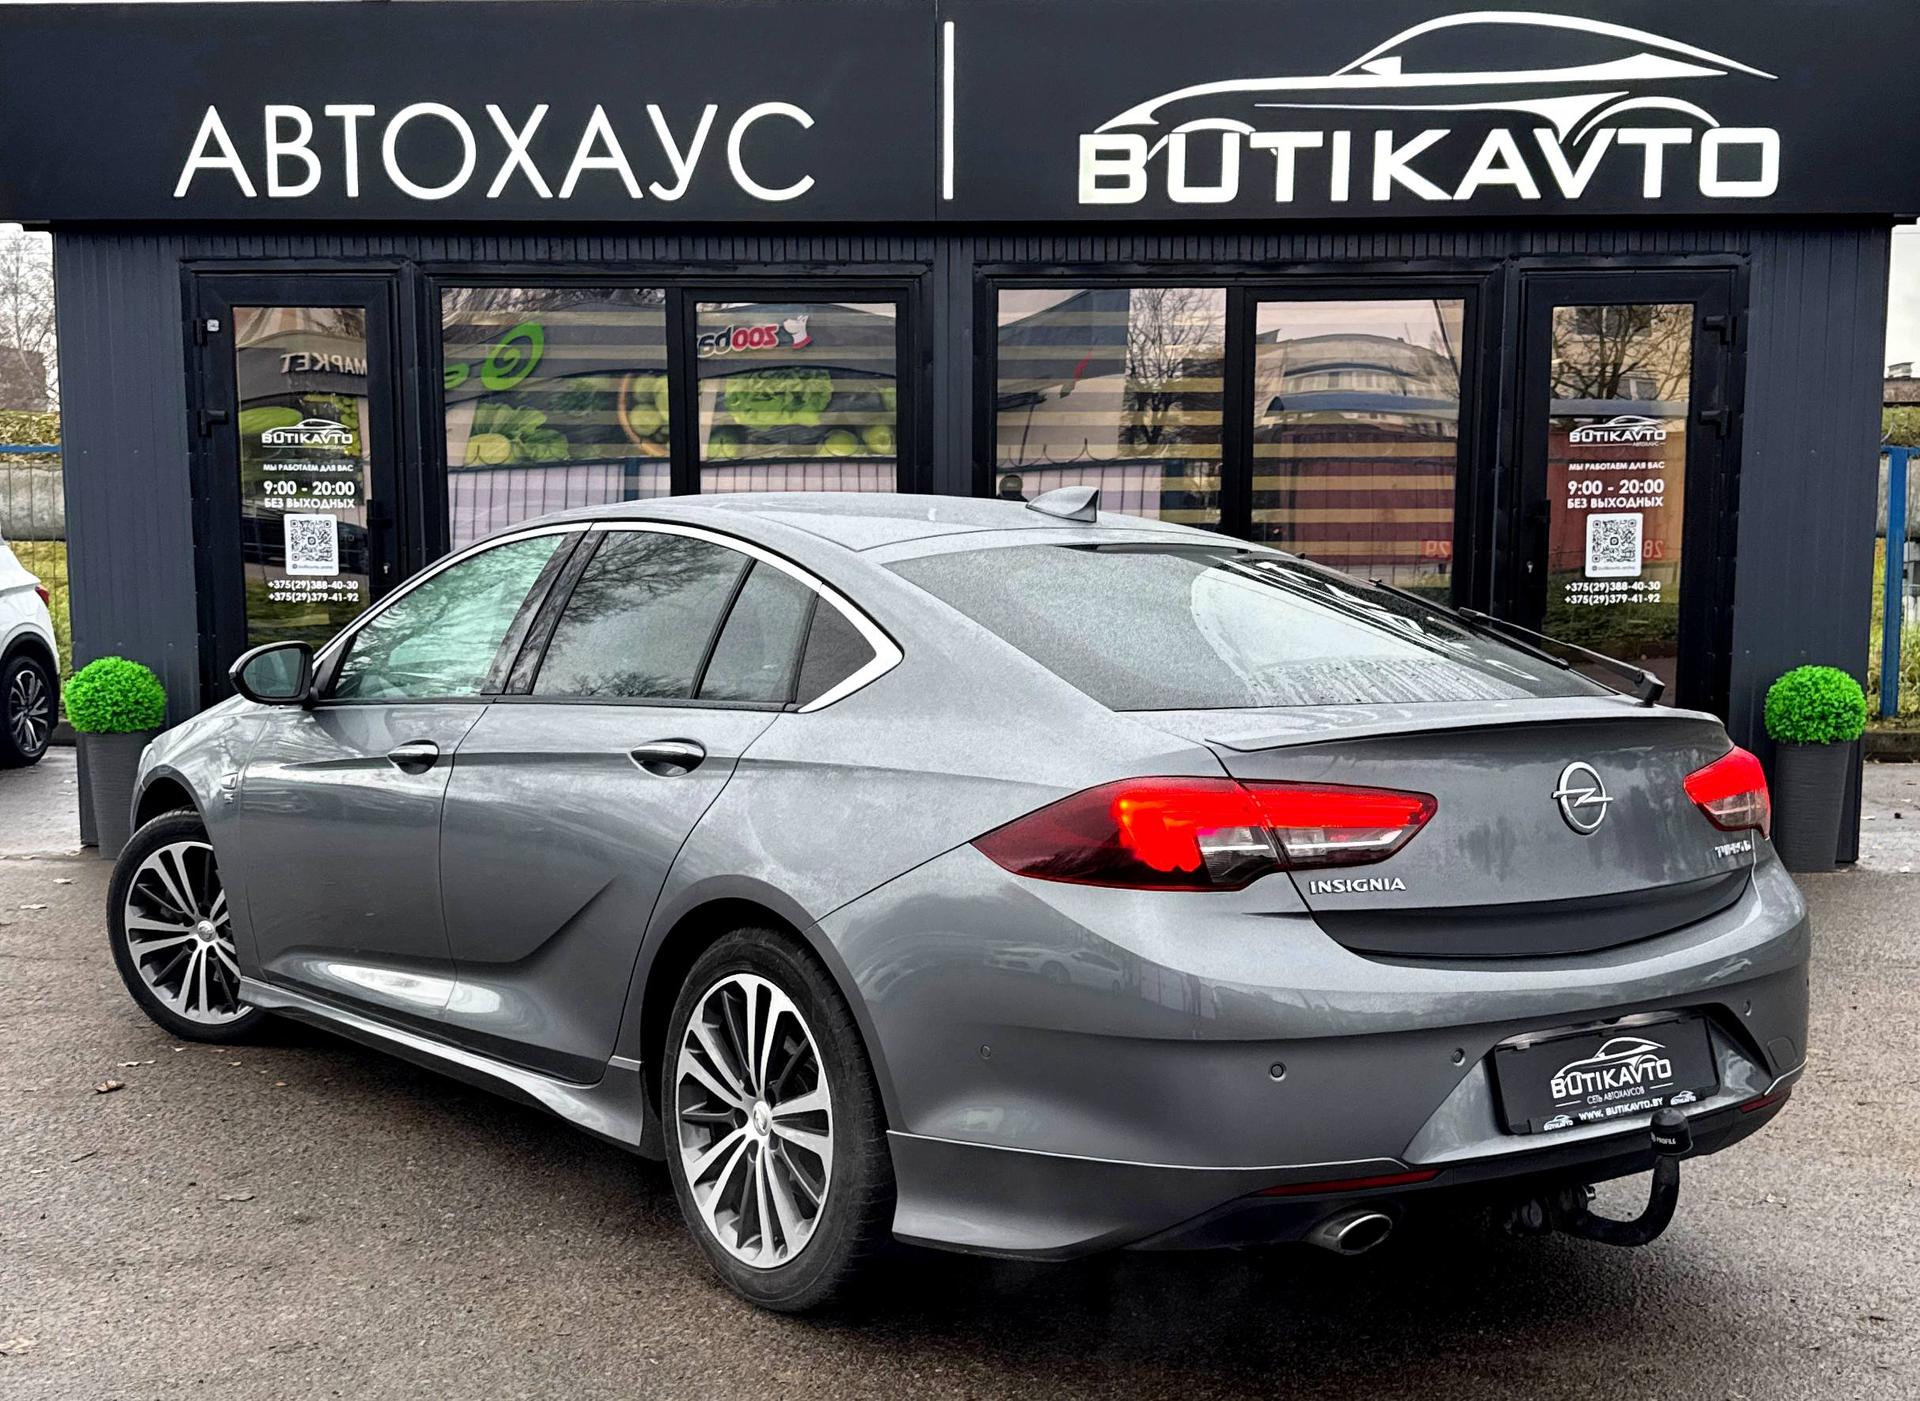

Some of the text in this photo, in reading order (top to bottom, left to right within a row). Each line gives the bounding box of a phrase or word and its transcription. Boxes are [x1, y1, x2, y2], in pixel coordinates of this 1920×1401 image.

[173, 102, 816, 201] АВТОХАУС
[1079, 127, 1781, 204] BUTIKAVTO
[261, 432, 353, 444] BUTIKAVTO
[1569, 430, 1667, 442] BUTIKAVTO
[278, 464, 319, 472] РАБОТАЕМ
[319, 464, 336, 473] ДЛЯ
[337, 464, 354, 472] ВАС
[1584, 463, 1628, 471] РАБОТАЕМ
[1629, 462, 1646, 470] ДЛЯ
[263, 480, 297, 495] 9:00
[312, 481, 355, 496] 20:00
[1567, 480, 1603, 495] 9:00
[1619, 478, 1665, 494] 20:00
[264, 498, 355, 509] БЕЗ ВЫХОДНЫХ
[1567, 496, 1664, 509] БЕЗ ВЫХОДНЫХ
[267, 580, 359, 591] +375(29)388-40-30
[1564, 581, 1661, 592] +375(29)388-40-30
[268, 592, 359, 603] +375(29)379-41-92
[1564, 593, 1661, 605] +375(29)379-41-92
[1310, 877, 1407, 894] INSIGNIA
[1550, 1059, 1673, 1099] BUTIKAVTO
[1586, 1086, 1645, 1105] СЕТЬ АВТОХАУСОВ
[1605, 1097, 1663, 1116] BUTIKAVTO.BY
